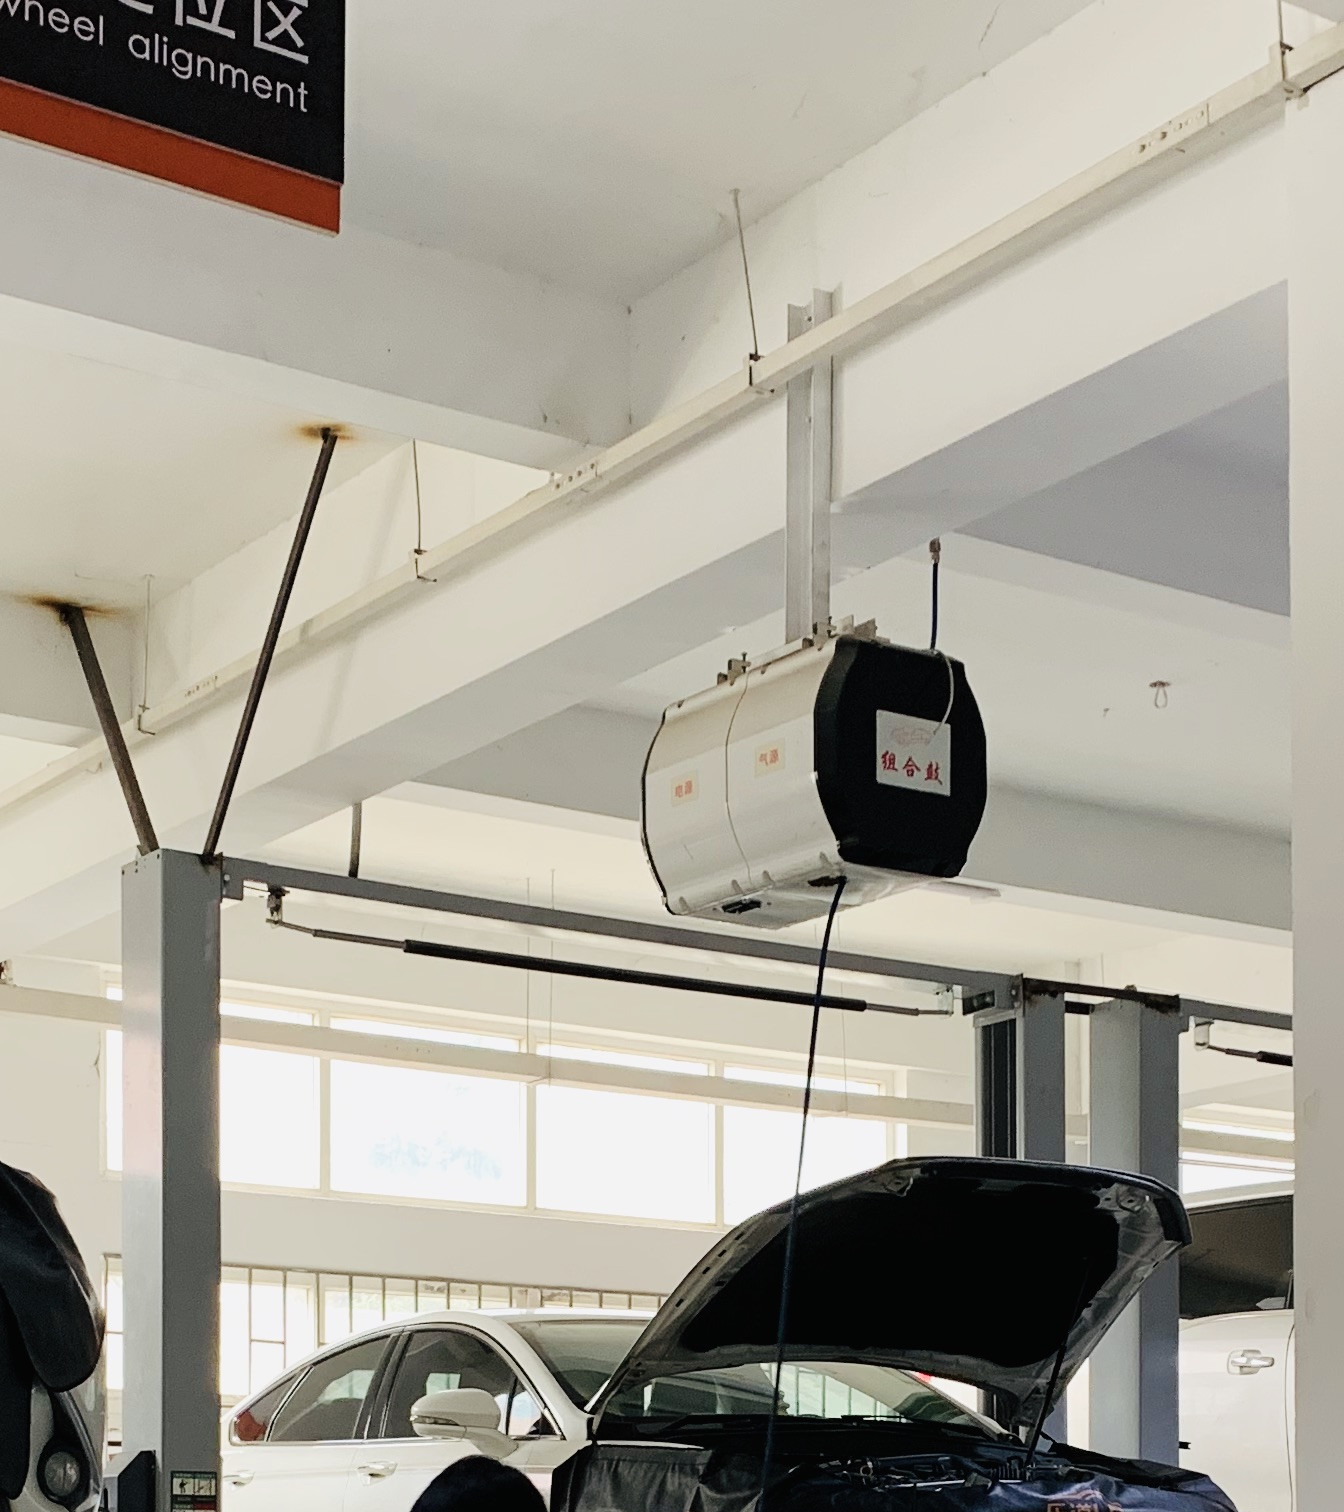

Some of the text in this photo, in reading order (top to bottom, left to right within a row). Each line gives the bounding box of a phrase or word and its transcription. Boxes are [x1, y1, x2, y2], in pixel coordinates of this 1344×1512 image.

[128, 33, 309, 112] alignment
[881, 750, 943, 786] 组合鼓
